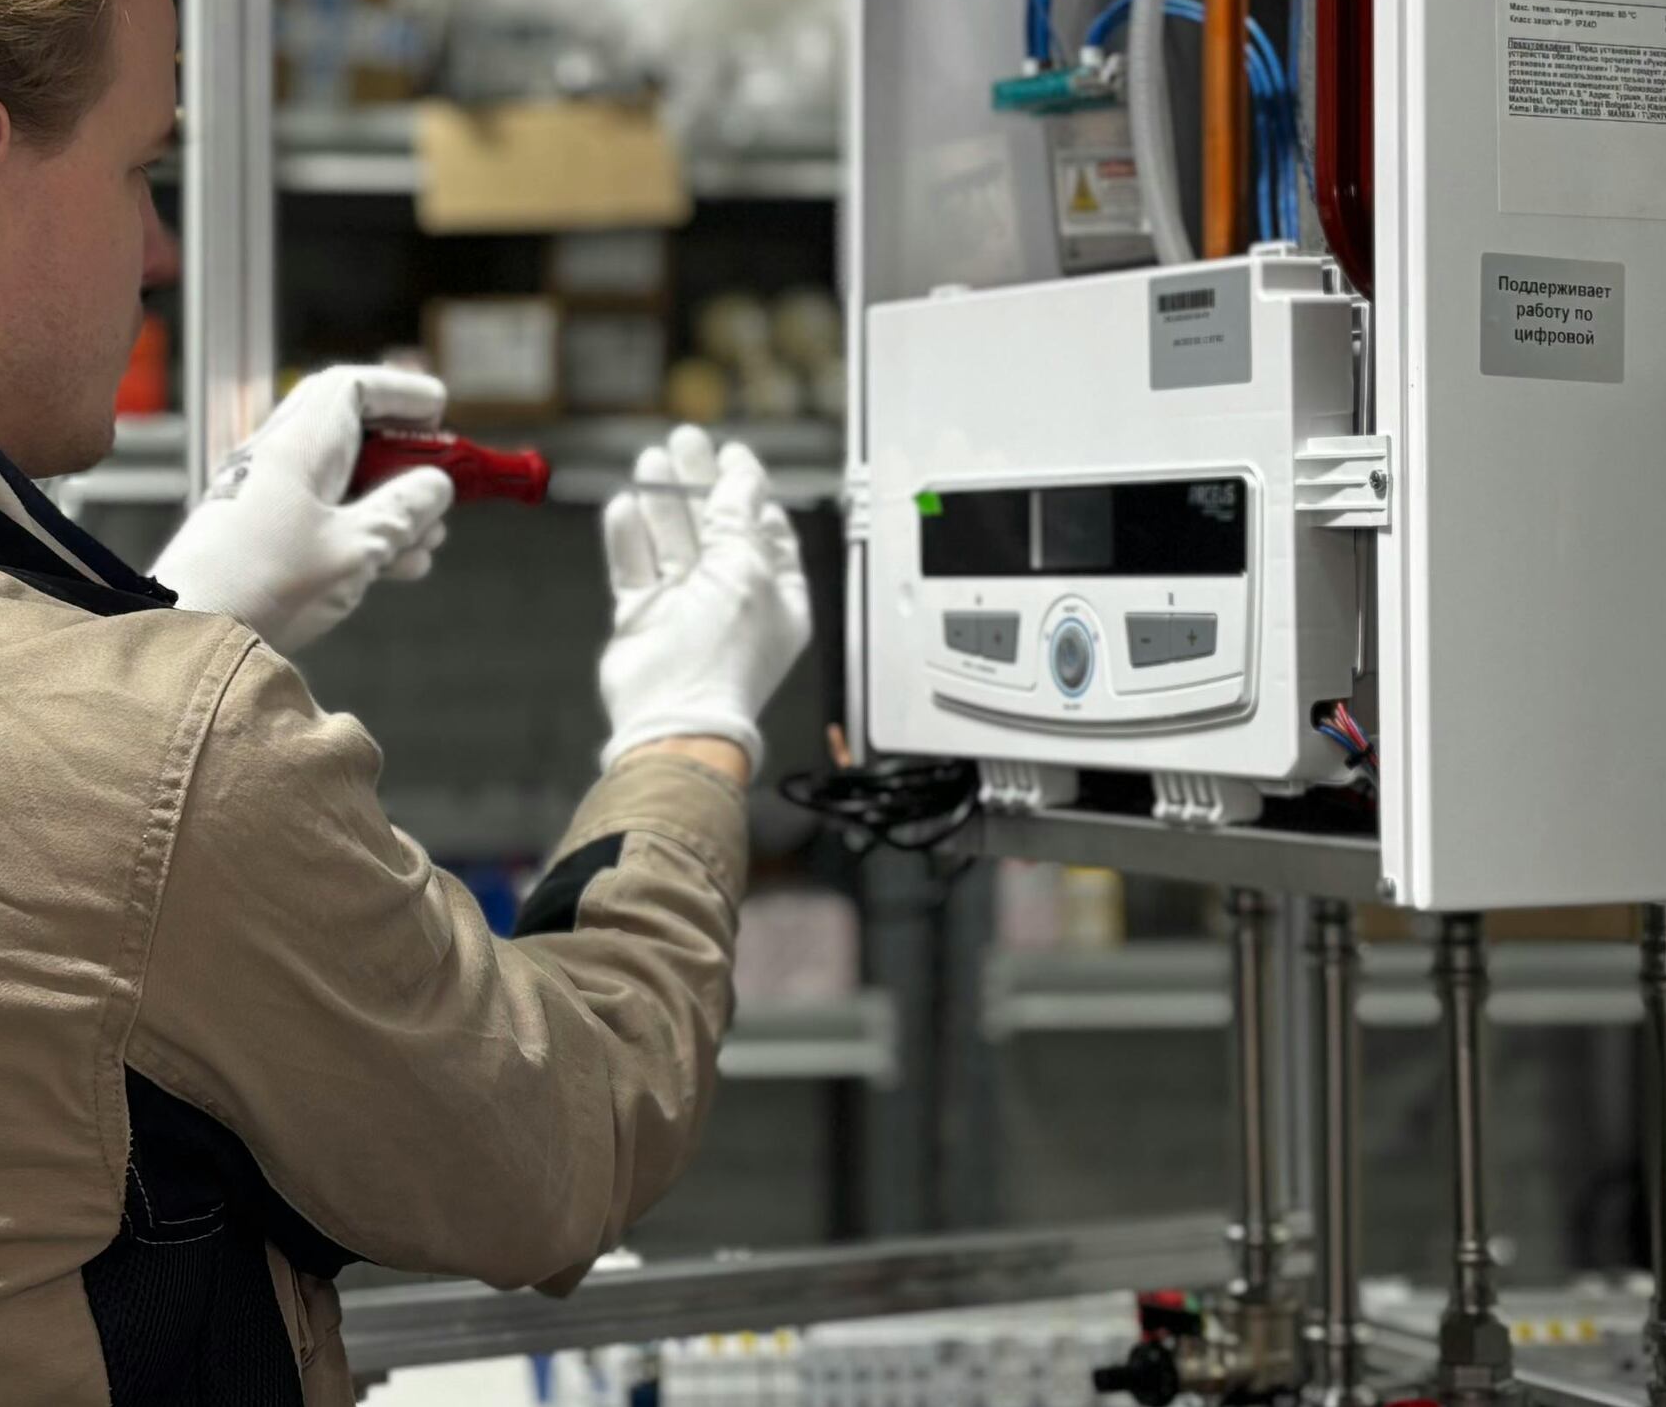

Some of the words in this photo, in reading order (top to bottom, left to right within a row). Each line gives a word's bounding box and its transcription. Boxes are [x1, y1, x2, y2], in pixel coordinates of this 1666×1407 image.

[1498, 275, 1612, 299] Поддерживает
[1516, 302, 1571, 324] работу
[1575, 308, 1594, 322] по
[1514, 326, 1595, 347] цифровой
